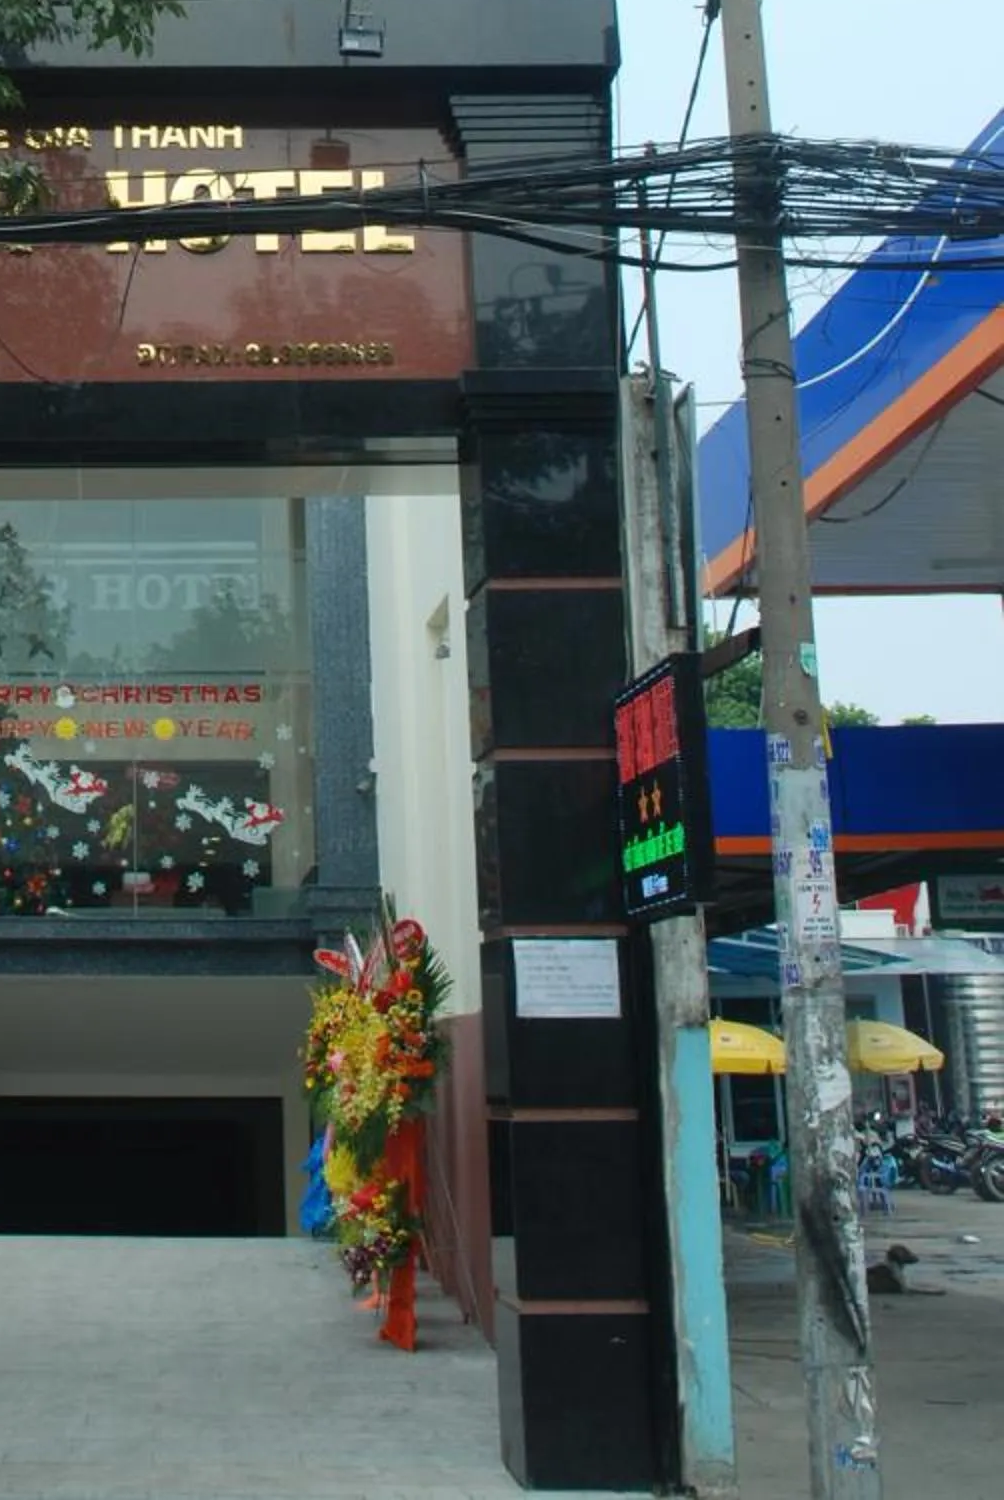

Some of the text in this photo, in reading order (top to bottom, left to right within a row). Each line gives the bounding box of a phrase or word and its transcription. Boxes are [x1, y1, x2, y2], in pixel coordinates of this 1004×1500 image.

[105, 168, 415, 254] HOTEL
[81, 684, 262, 706] CHRISTMAS
[84, 719, 147, 740] NEW
[178, 718, 255, 741] YEAR
